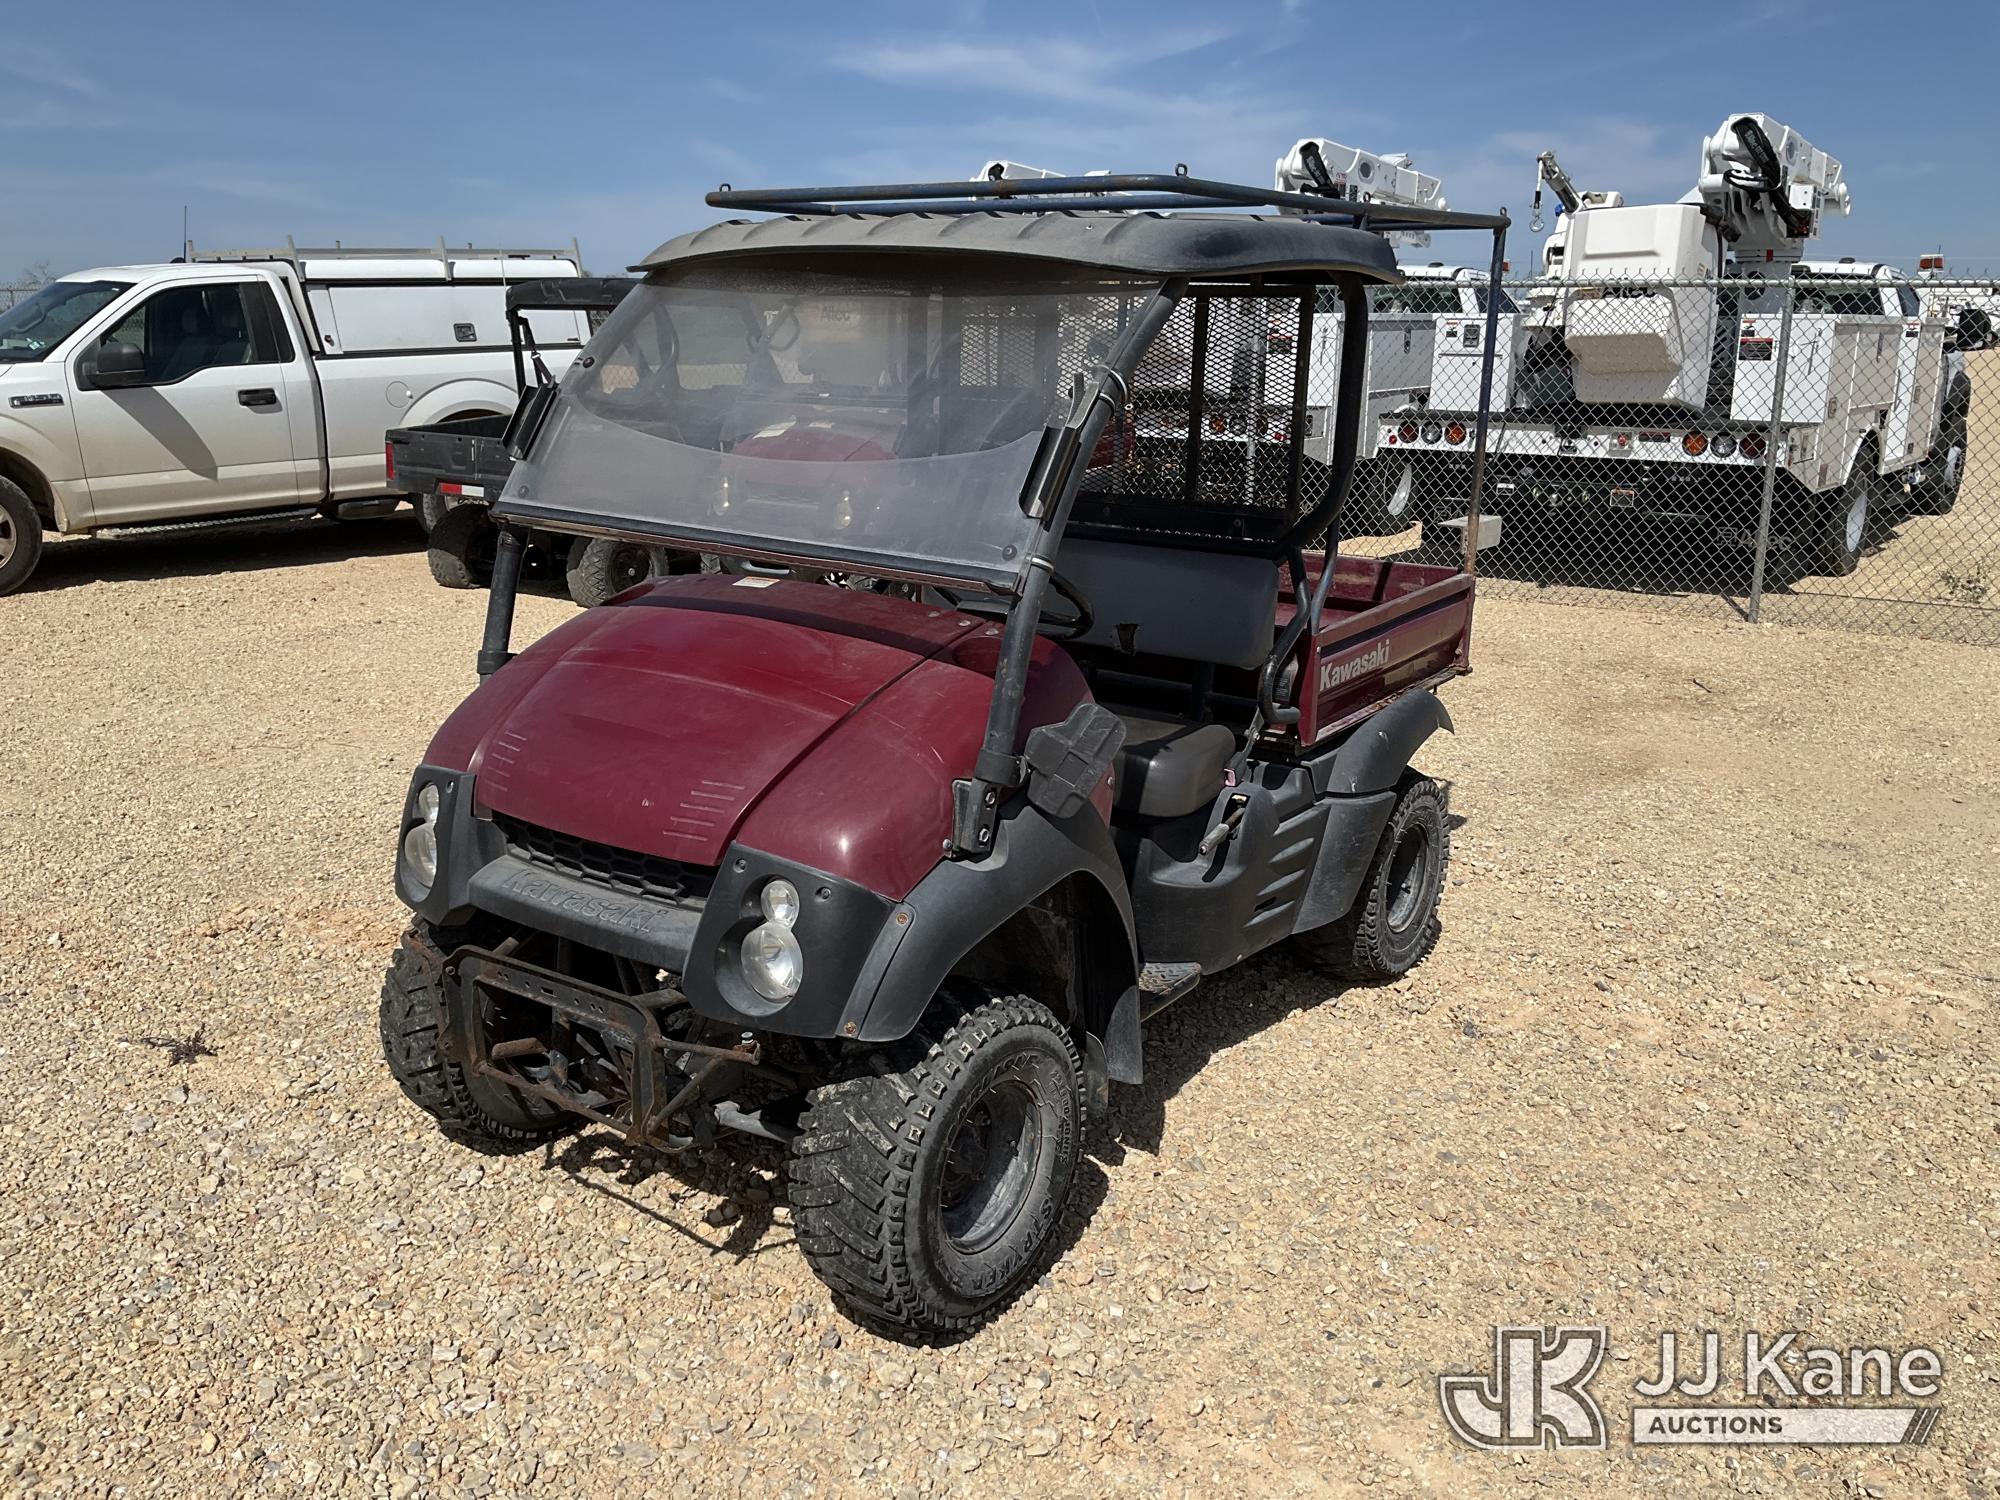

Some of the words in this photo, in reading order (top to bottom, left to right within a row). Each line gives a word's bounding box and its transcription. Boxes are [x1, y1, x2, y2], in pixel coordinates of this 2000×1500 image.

[1738, 528, 1794, 551] Alec
[1319, 639, 1390, 692] Kawasaki
[502, 868, 669, 932] Kawasaki
